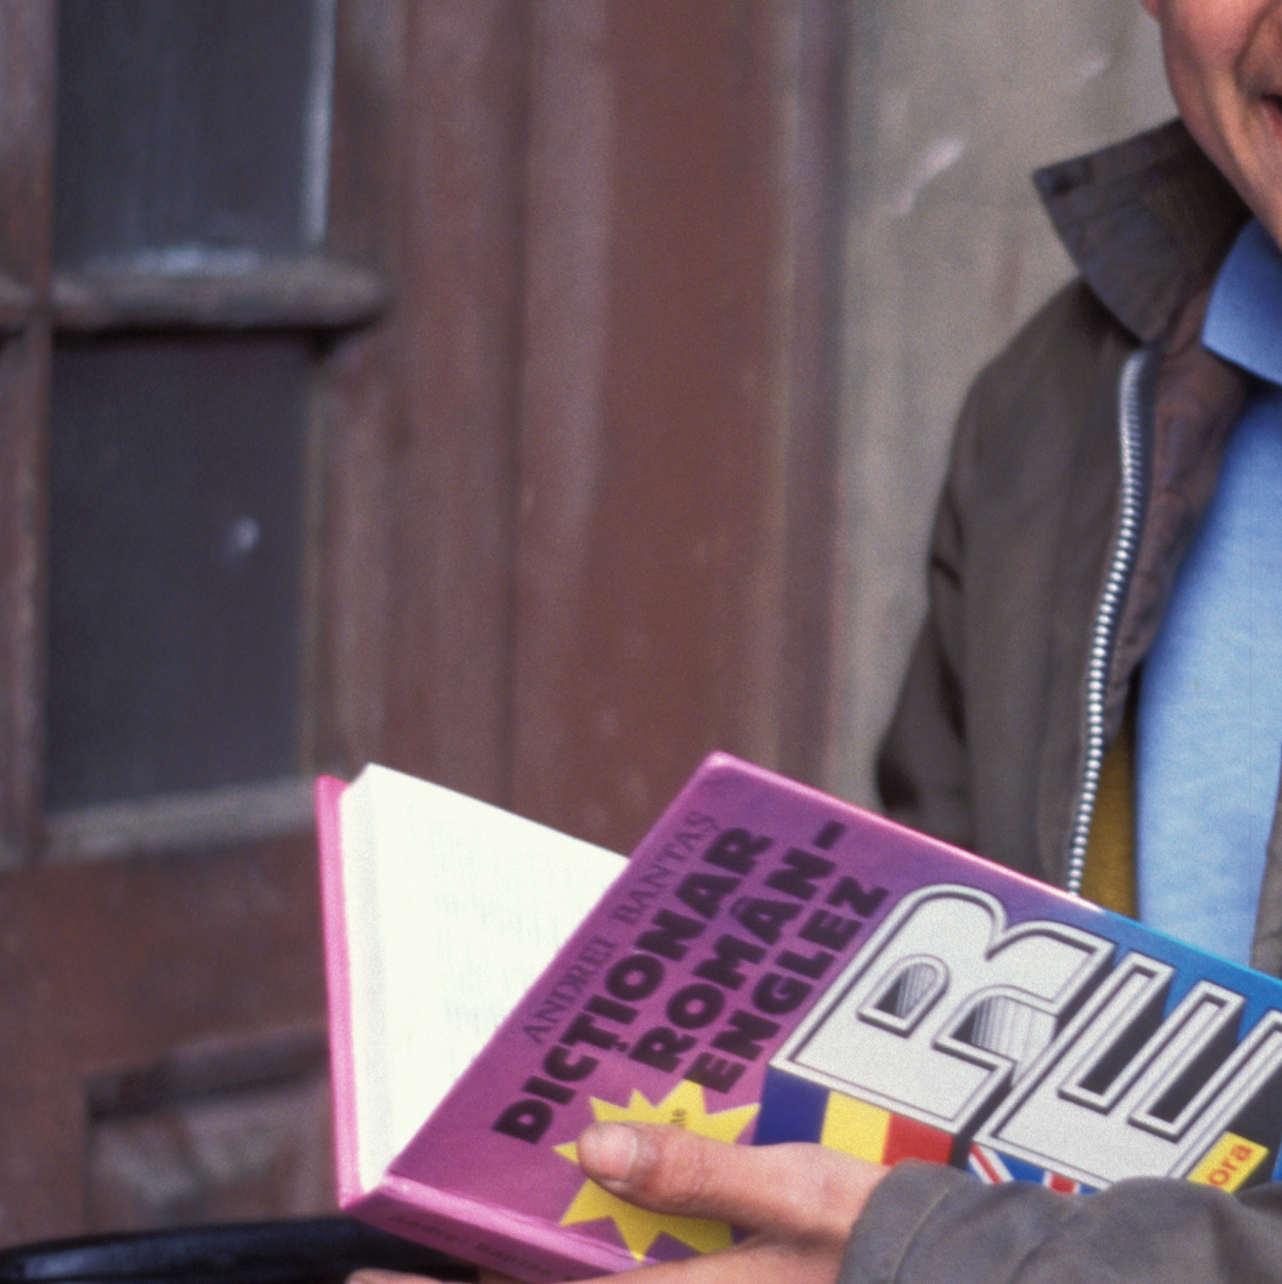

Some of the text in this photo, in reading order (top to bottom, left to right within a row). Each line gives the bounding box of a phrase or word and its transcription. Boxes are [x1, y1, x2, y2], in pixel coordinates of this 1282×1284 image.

[520, 937, 618, 1045] ANDREI
[627, 820, 849, 1074] ROMÂN-
[682, 875, 889, 1094] ENGLEZ
